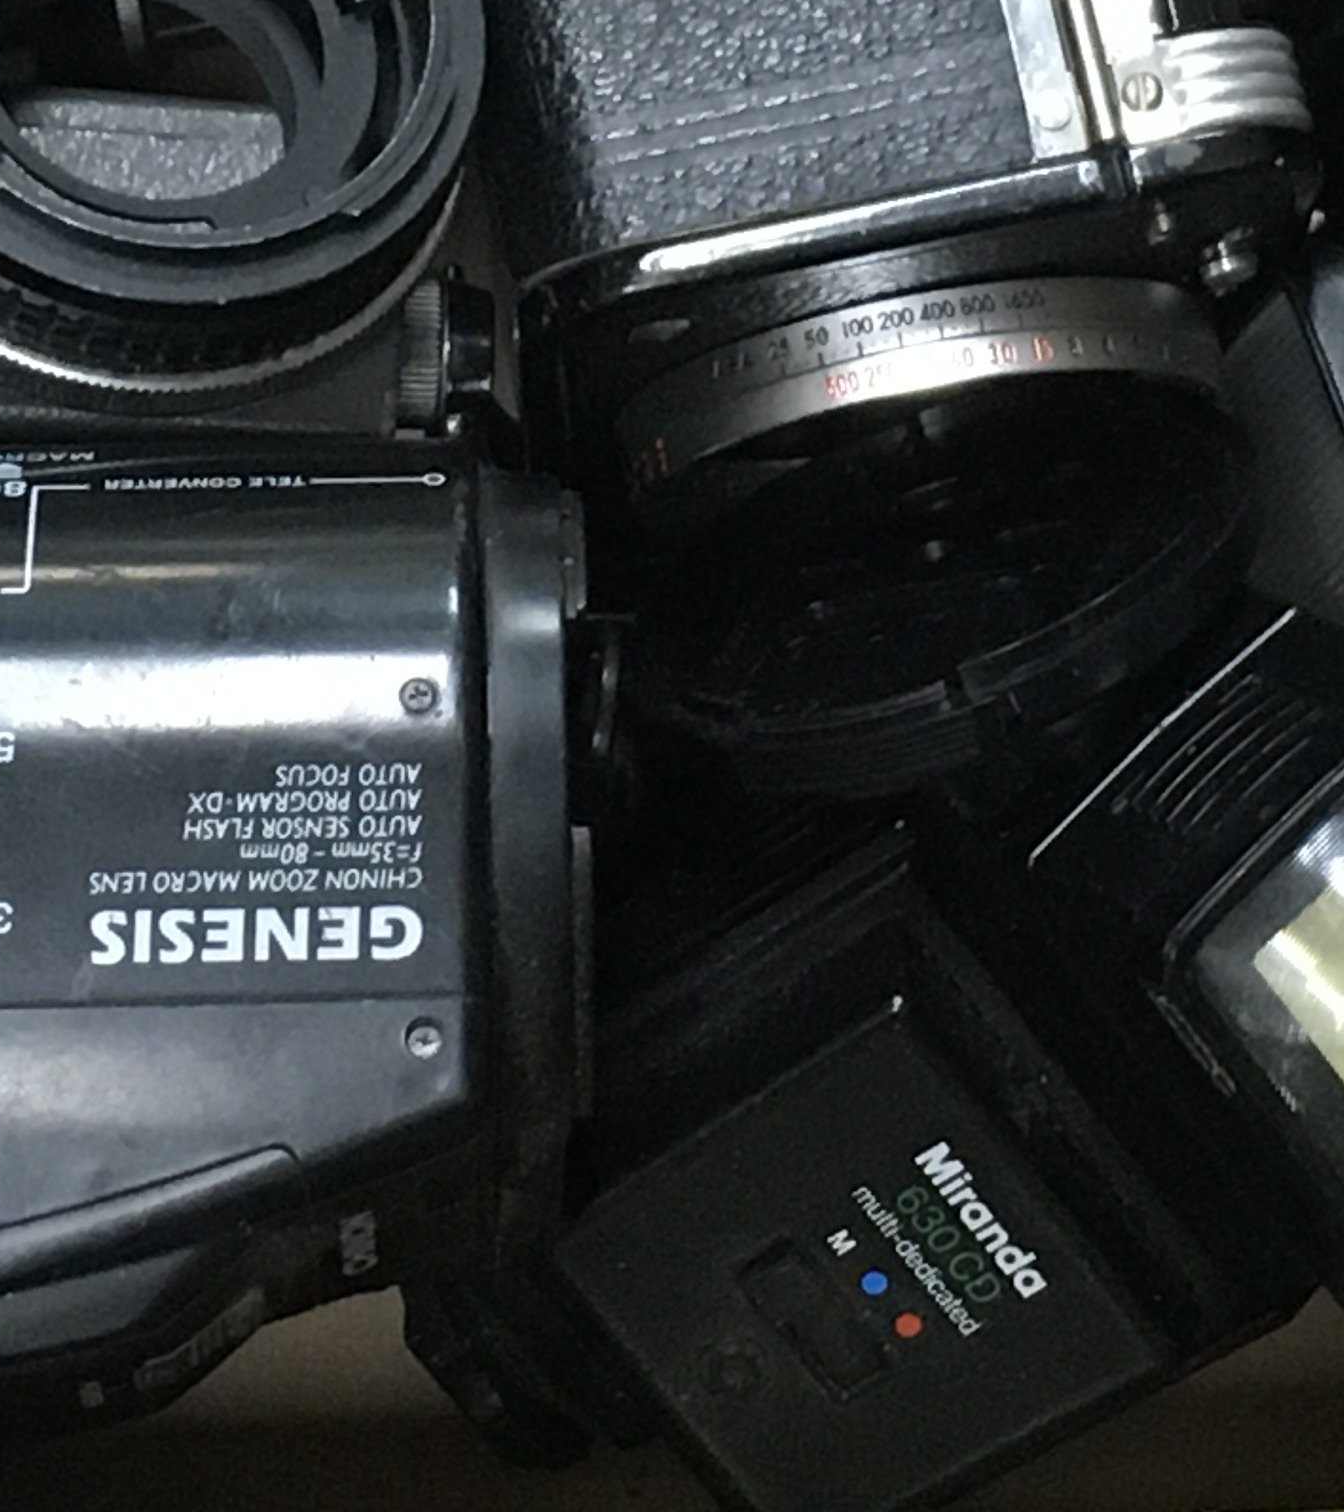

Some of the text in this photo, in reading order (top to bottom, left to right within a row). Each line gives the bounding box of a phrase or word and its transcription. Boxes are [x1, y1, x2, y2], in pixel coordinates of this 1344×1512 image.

[804, 326, 829, 349] 50
[842, 315, 874, 338] 100
[878, 307, 914, 331] 200
[920, 300, 955, 321] 400
[104, 475, 306, 491] TELE CONVERTER
[275, 763, 422, 787] AUTO FOCUS
[358, 789, 422, 811] AUTO
[183, 815, 422, 841] AUTO SENSOR FLASH
[240, 844, 308, 866] 80mm
[332, 842, 422, 864] f=35mm
[89, 868, 423, 895] CHINON ZOOM MACRO LENS
[90, 905, 424, 966] GENESIS
[914, 1141, 1047, 1299] Miranda
[826, 1228, 857, 1257] M
[851, 1186, 983, 1337] multi-dedicated
